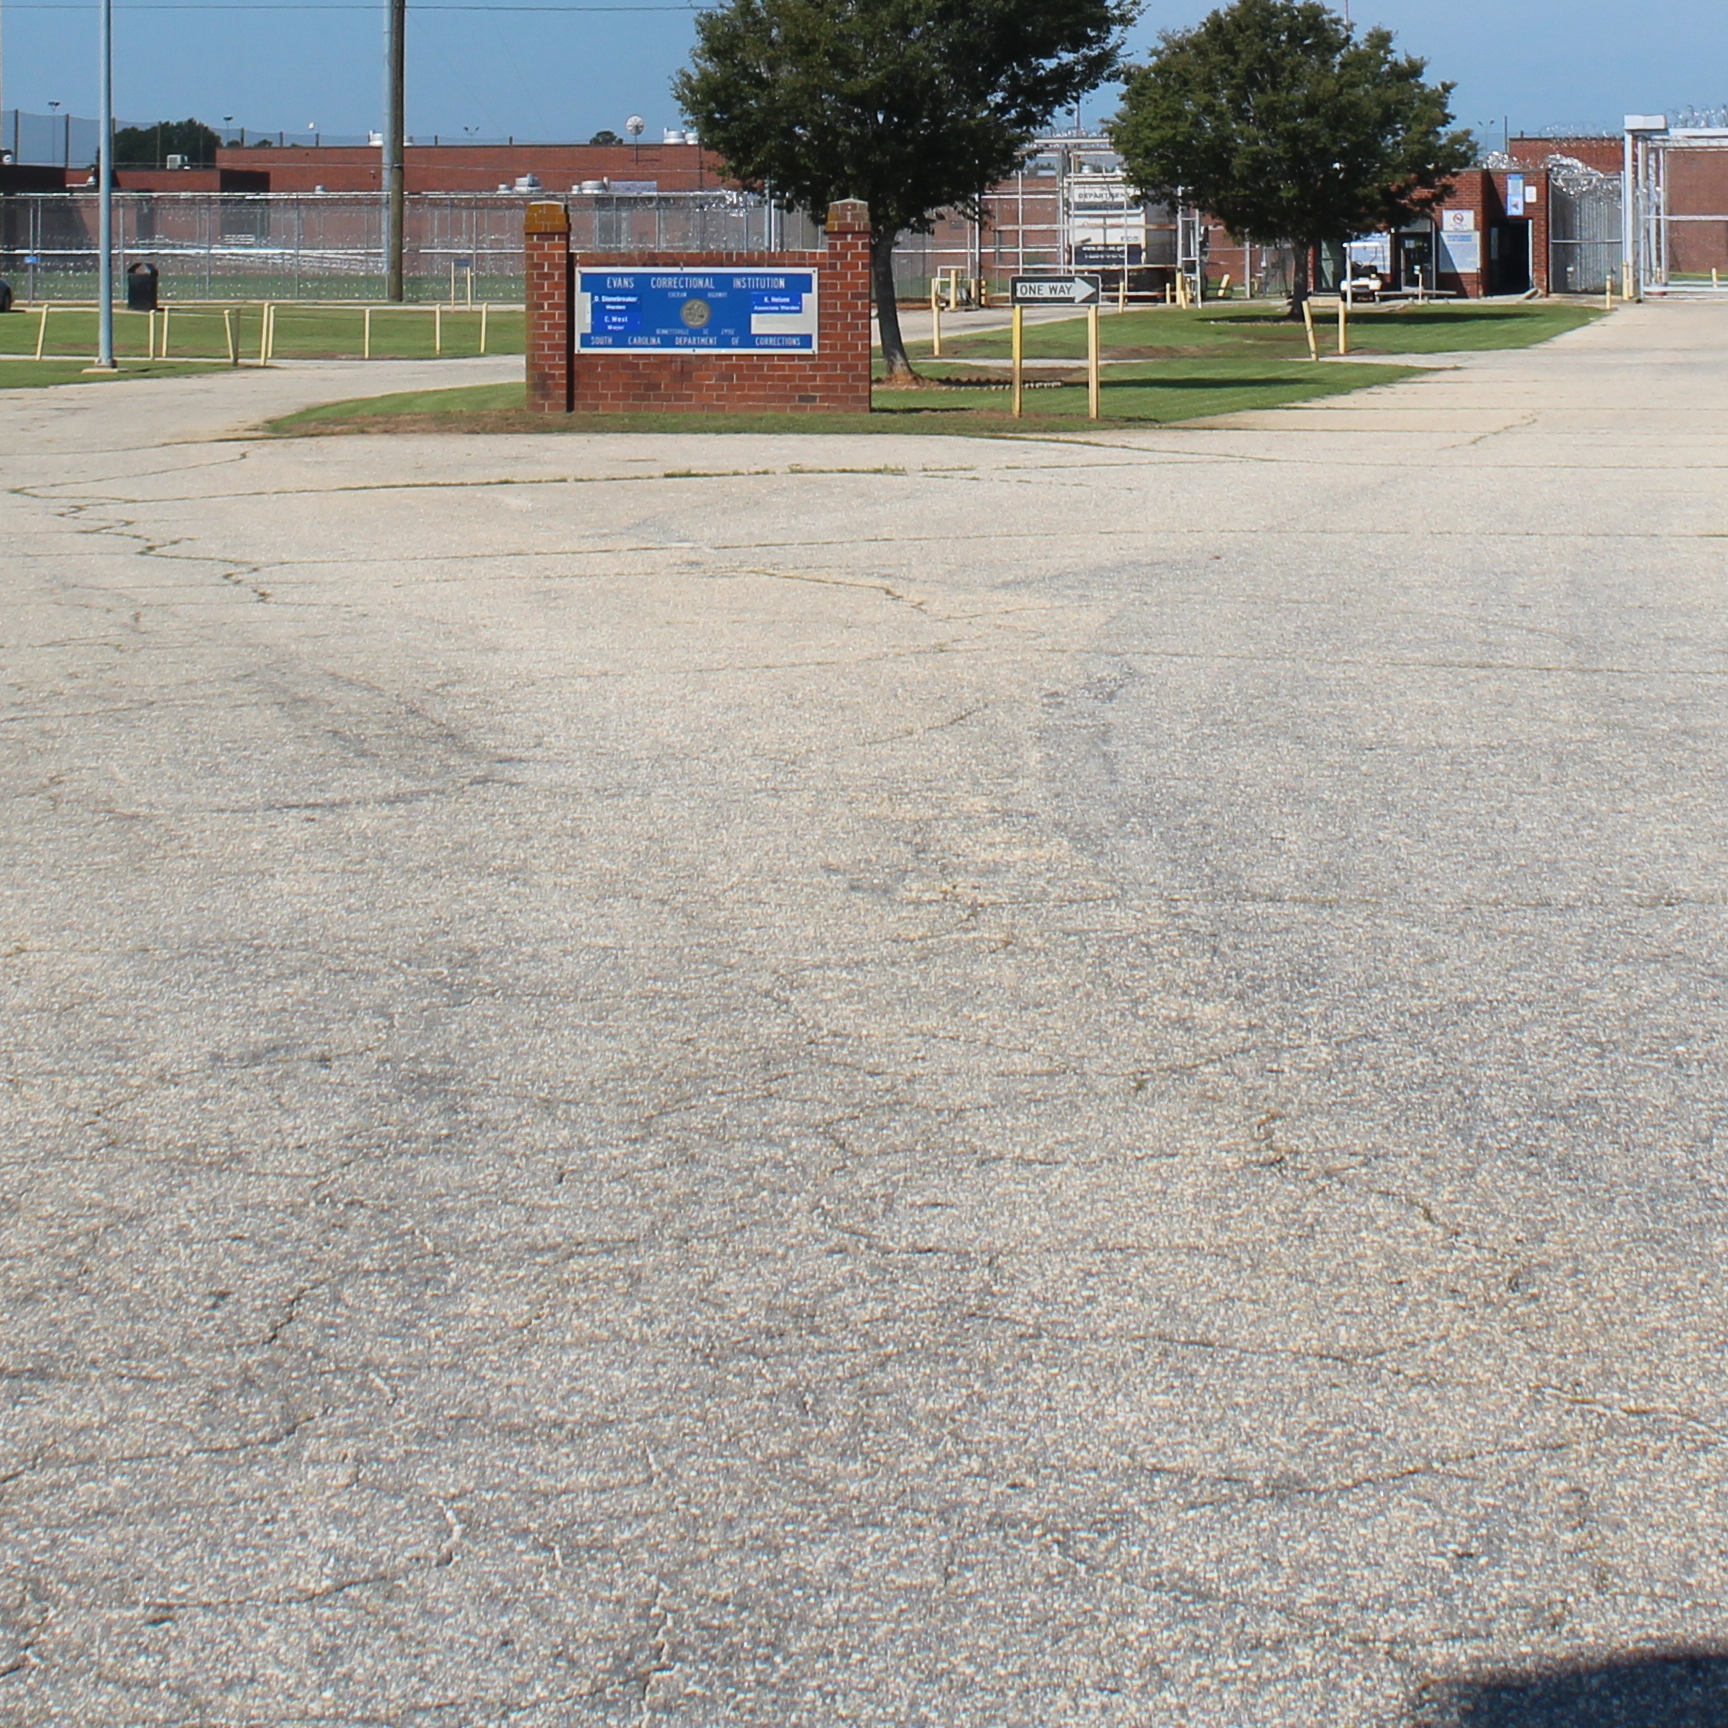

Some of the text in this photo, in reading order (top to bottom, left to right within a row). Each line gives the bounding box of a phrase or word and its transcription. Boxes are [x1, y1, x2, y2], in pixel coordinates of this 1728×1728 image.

[606, 277, 786, 289] EVANS CORRECTIONAL INSTITUTION
[1020, 284, 1073, 295] ONE WAY
[591, 336, 801, 346] SOUTH CAROLINA DEPARTMENT OF CORRECTIONS
